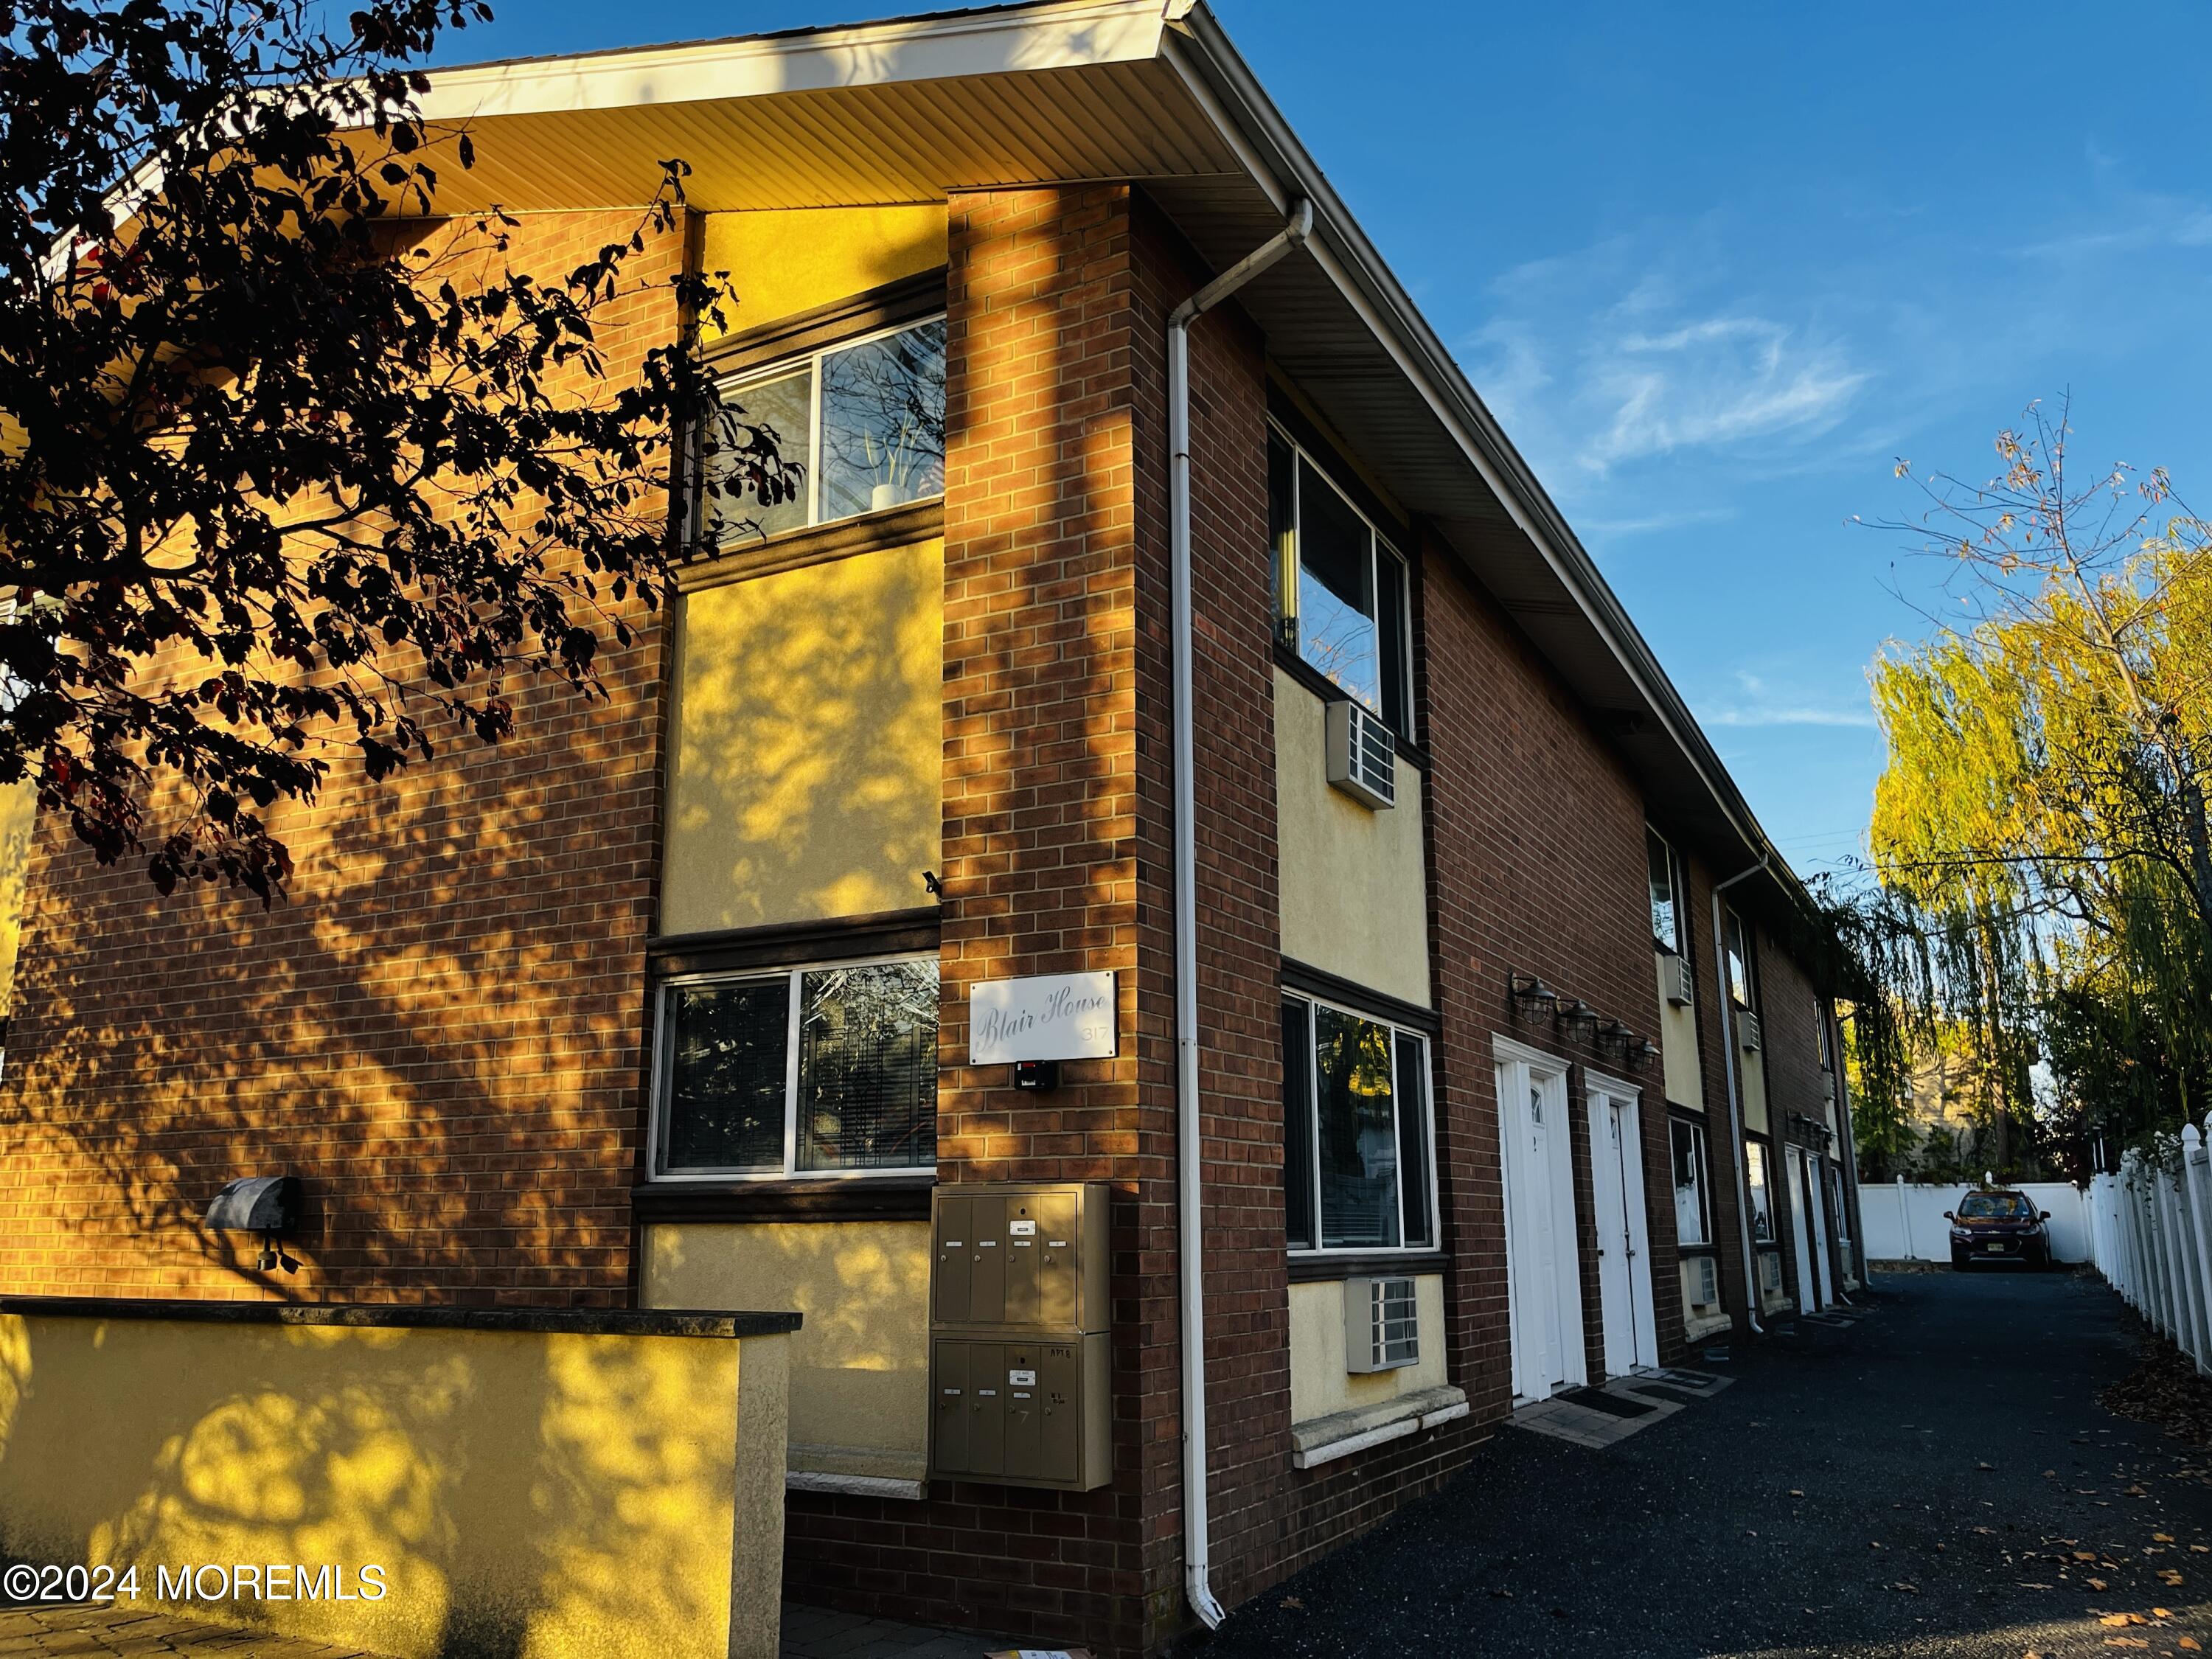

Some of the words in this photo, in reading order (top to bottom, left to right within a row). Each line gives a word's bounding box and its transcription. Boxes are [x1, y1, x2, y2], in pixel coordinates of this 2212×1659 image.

[975, 1007, 1037, 1053] Blair
[1041, 986, 1107, 1023] House
[1082, 1026, 1109, 1041] 317
[1050, 1349, 1064, 1357] APT
[1020, 1410, 1029, 1425] 7
